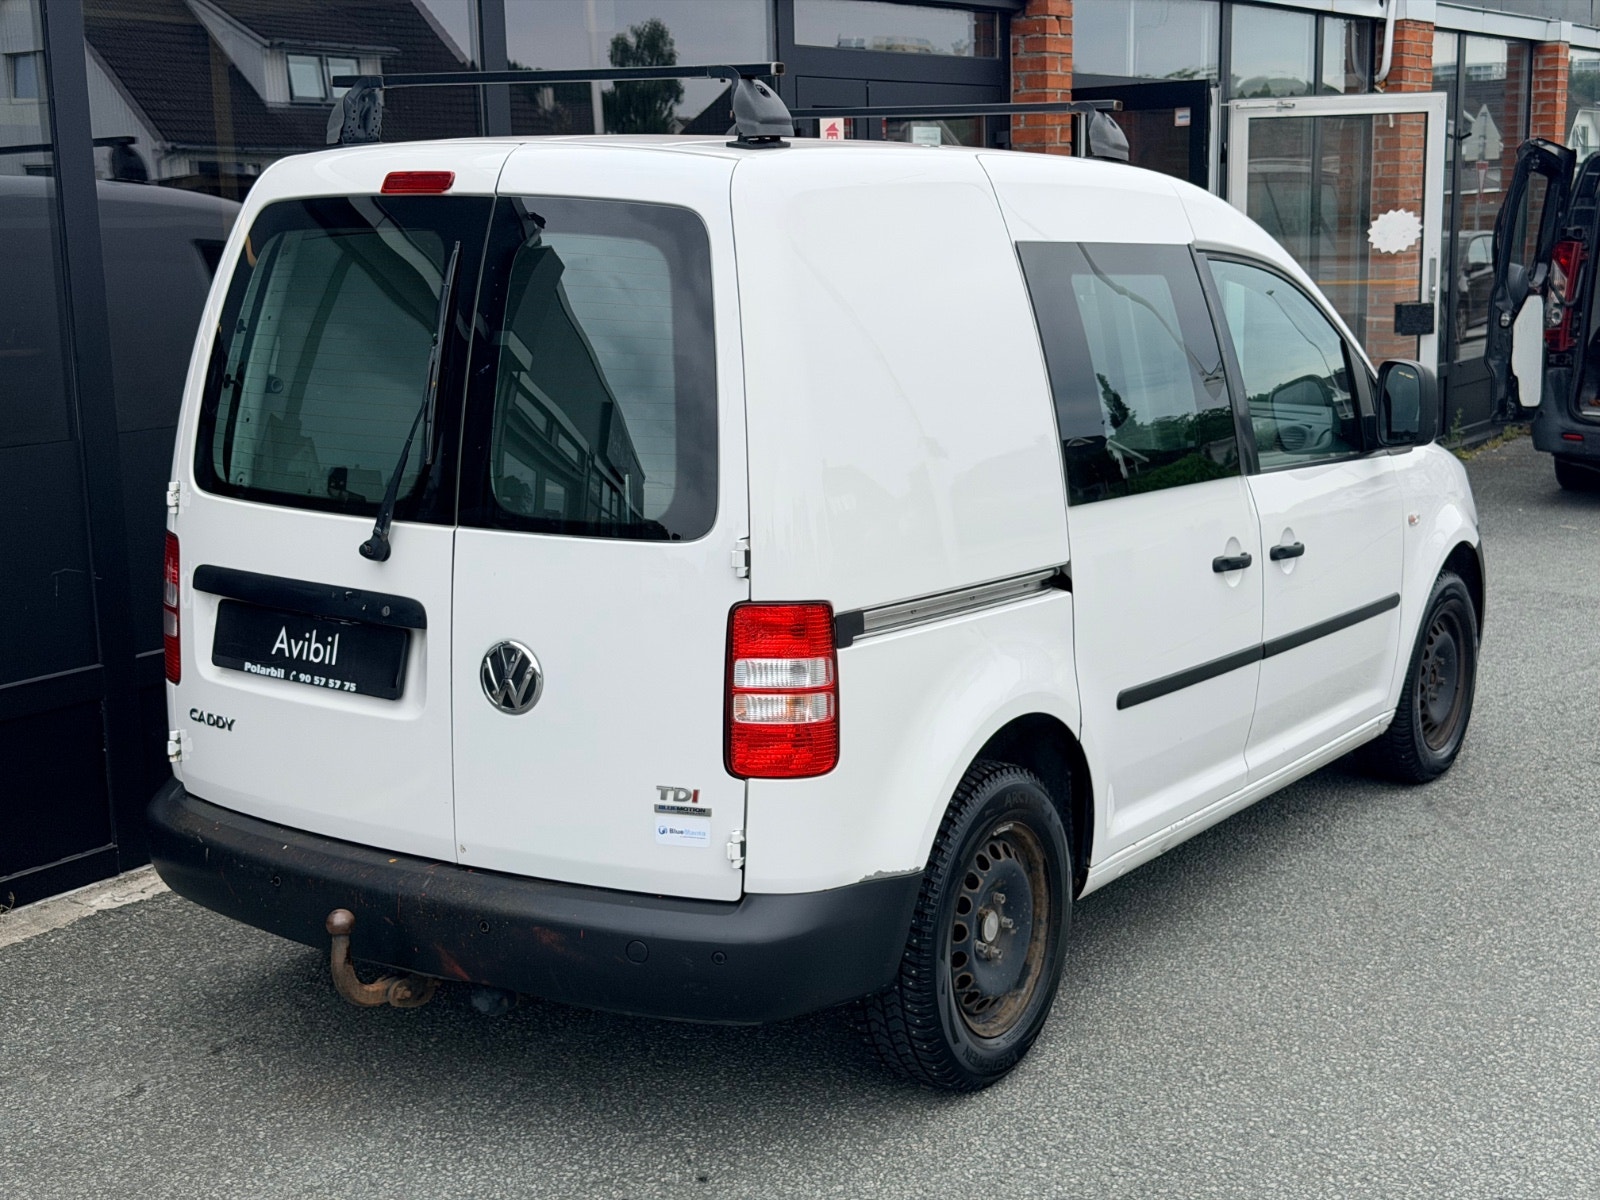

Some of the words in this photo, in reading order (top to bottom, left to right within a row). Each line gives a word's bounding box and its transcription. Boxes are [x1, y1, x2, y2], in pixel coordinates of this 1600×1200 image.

[270, 625, 340, 666] Avibil
[243, 661, 285, 679] Polarbil
[299, 673, 312, 684] 90
[313, 675, 326, 687] 57
[328, 678, 341, 689] 57
[343, 681, 357, 692] 75
[189, 707, 236, 732] CADDY
[655, 785, 700, 804] TDI
